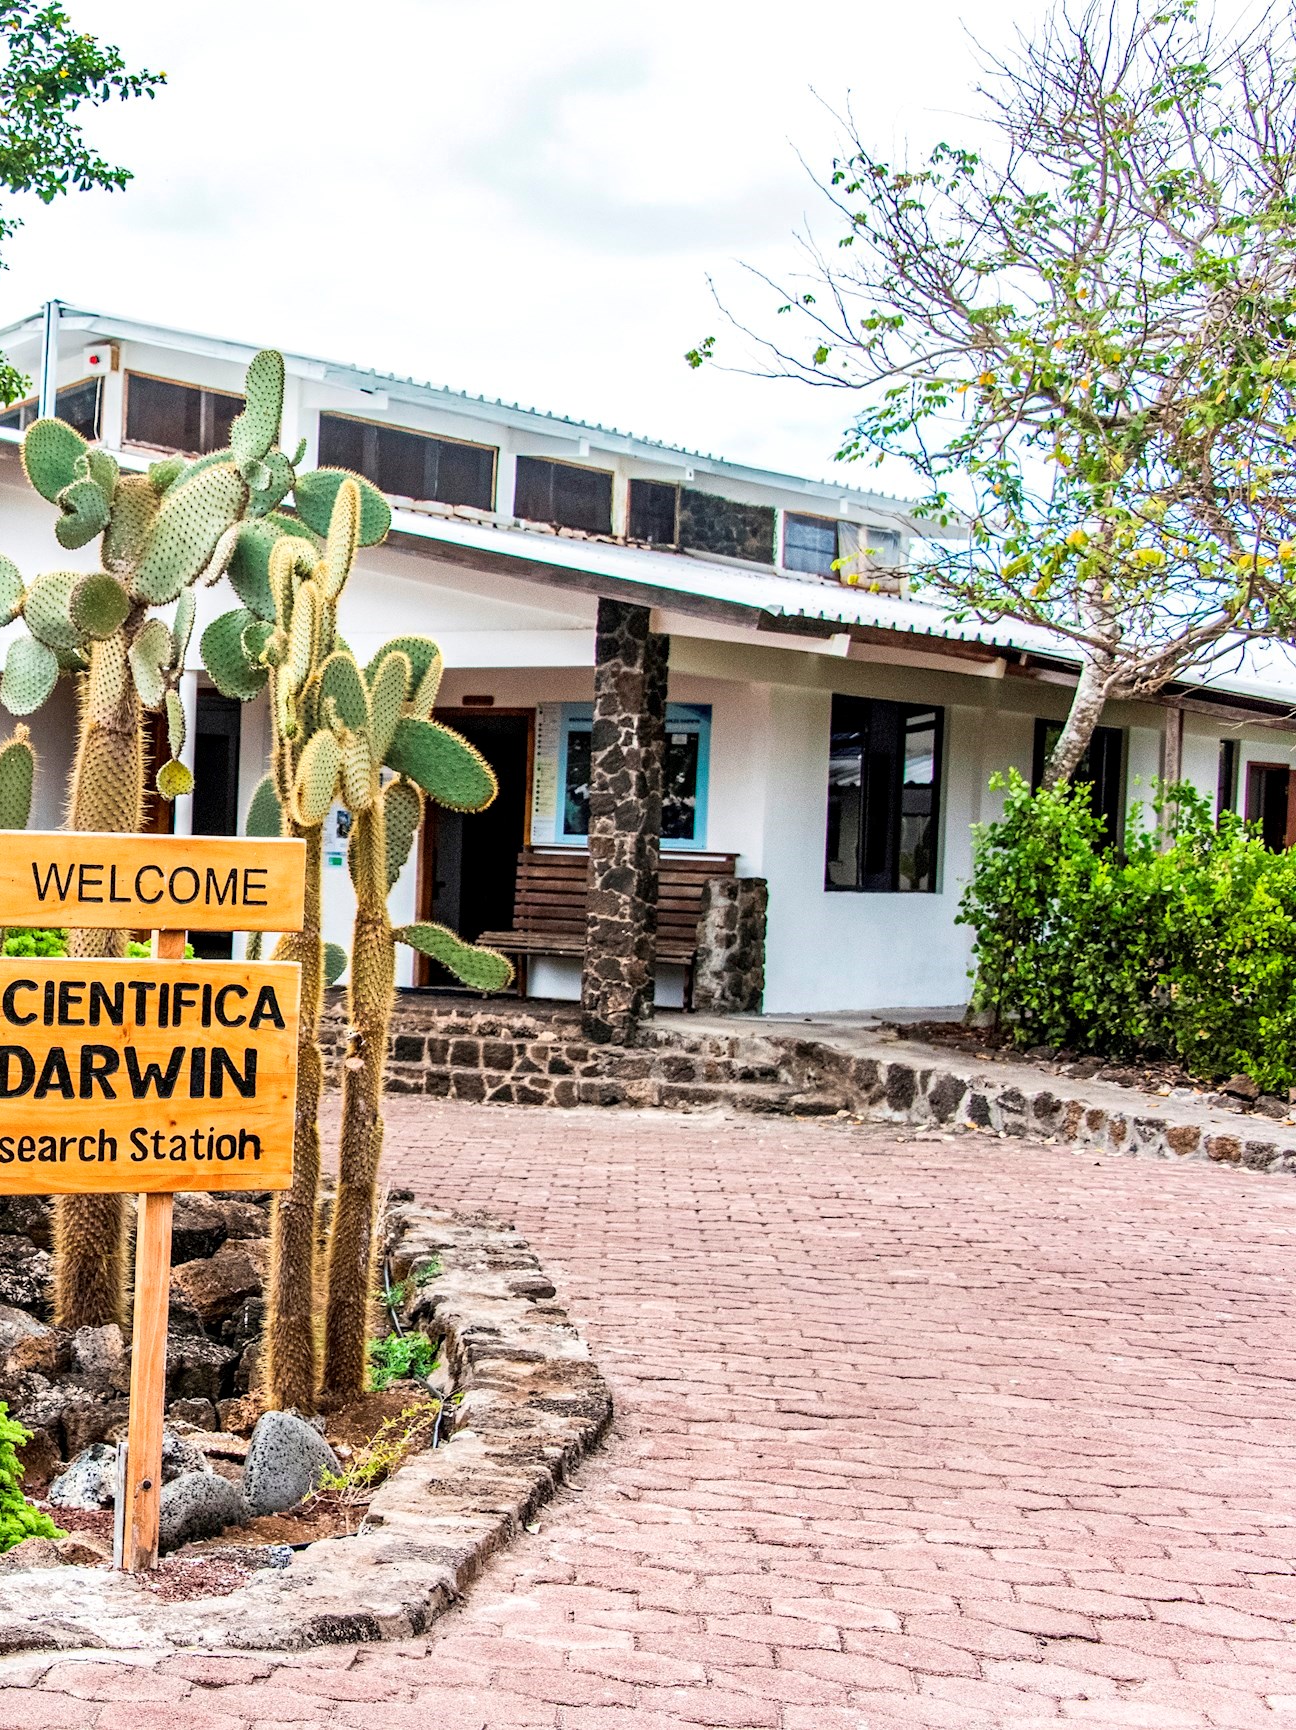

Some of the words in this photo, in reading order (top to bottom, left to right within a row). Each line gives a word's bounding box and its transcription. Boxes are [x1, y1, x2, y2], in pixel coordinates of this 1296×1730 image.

[31, 862, 268, 906] WELCOME
[1, 979, 286, 1031] CIENTIFICA
[129, 1127, 265, 1162] Station
